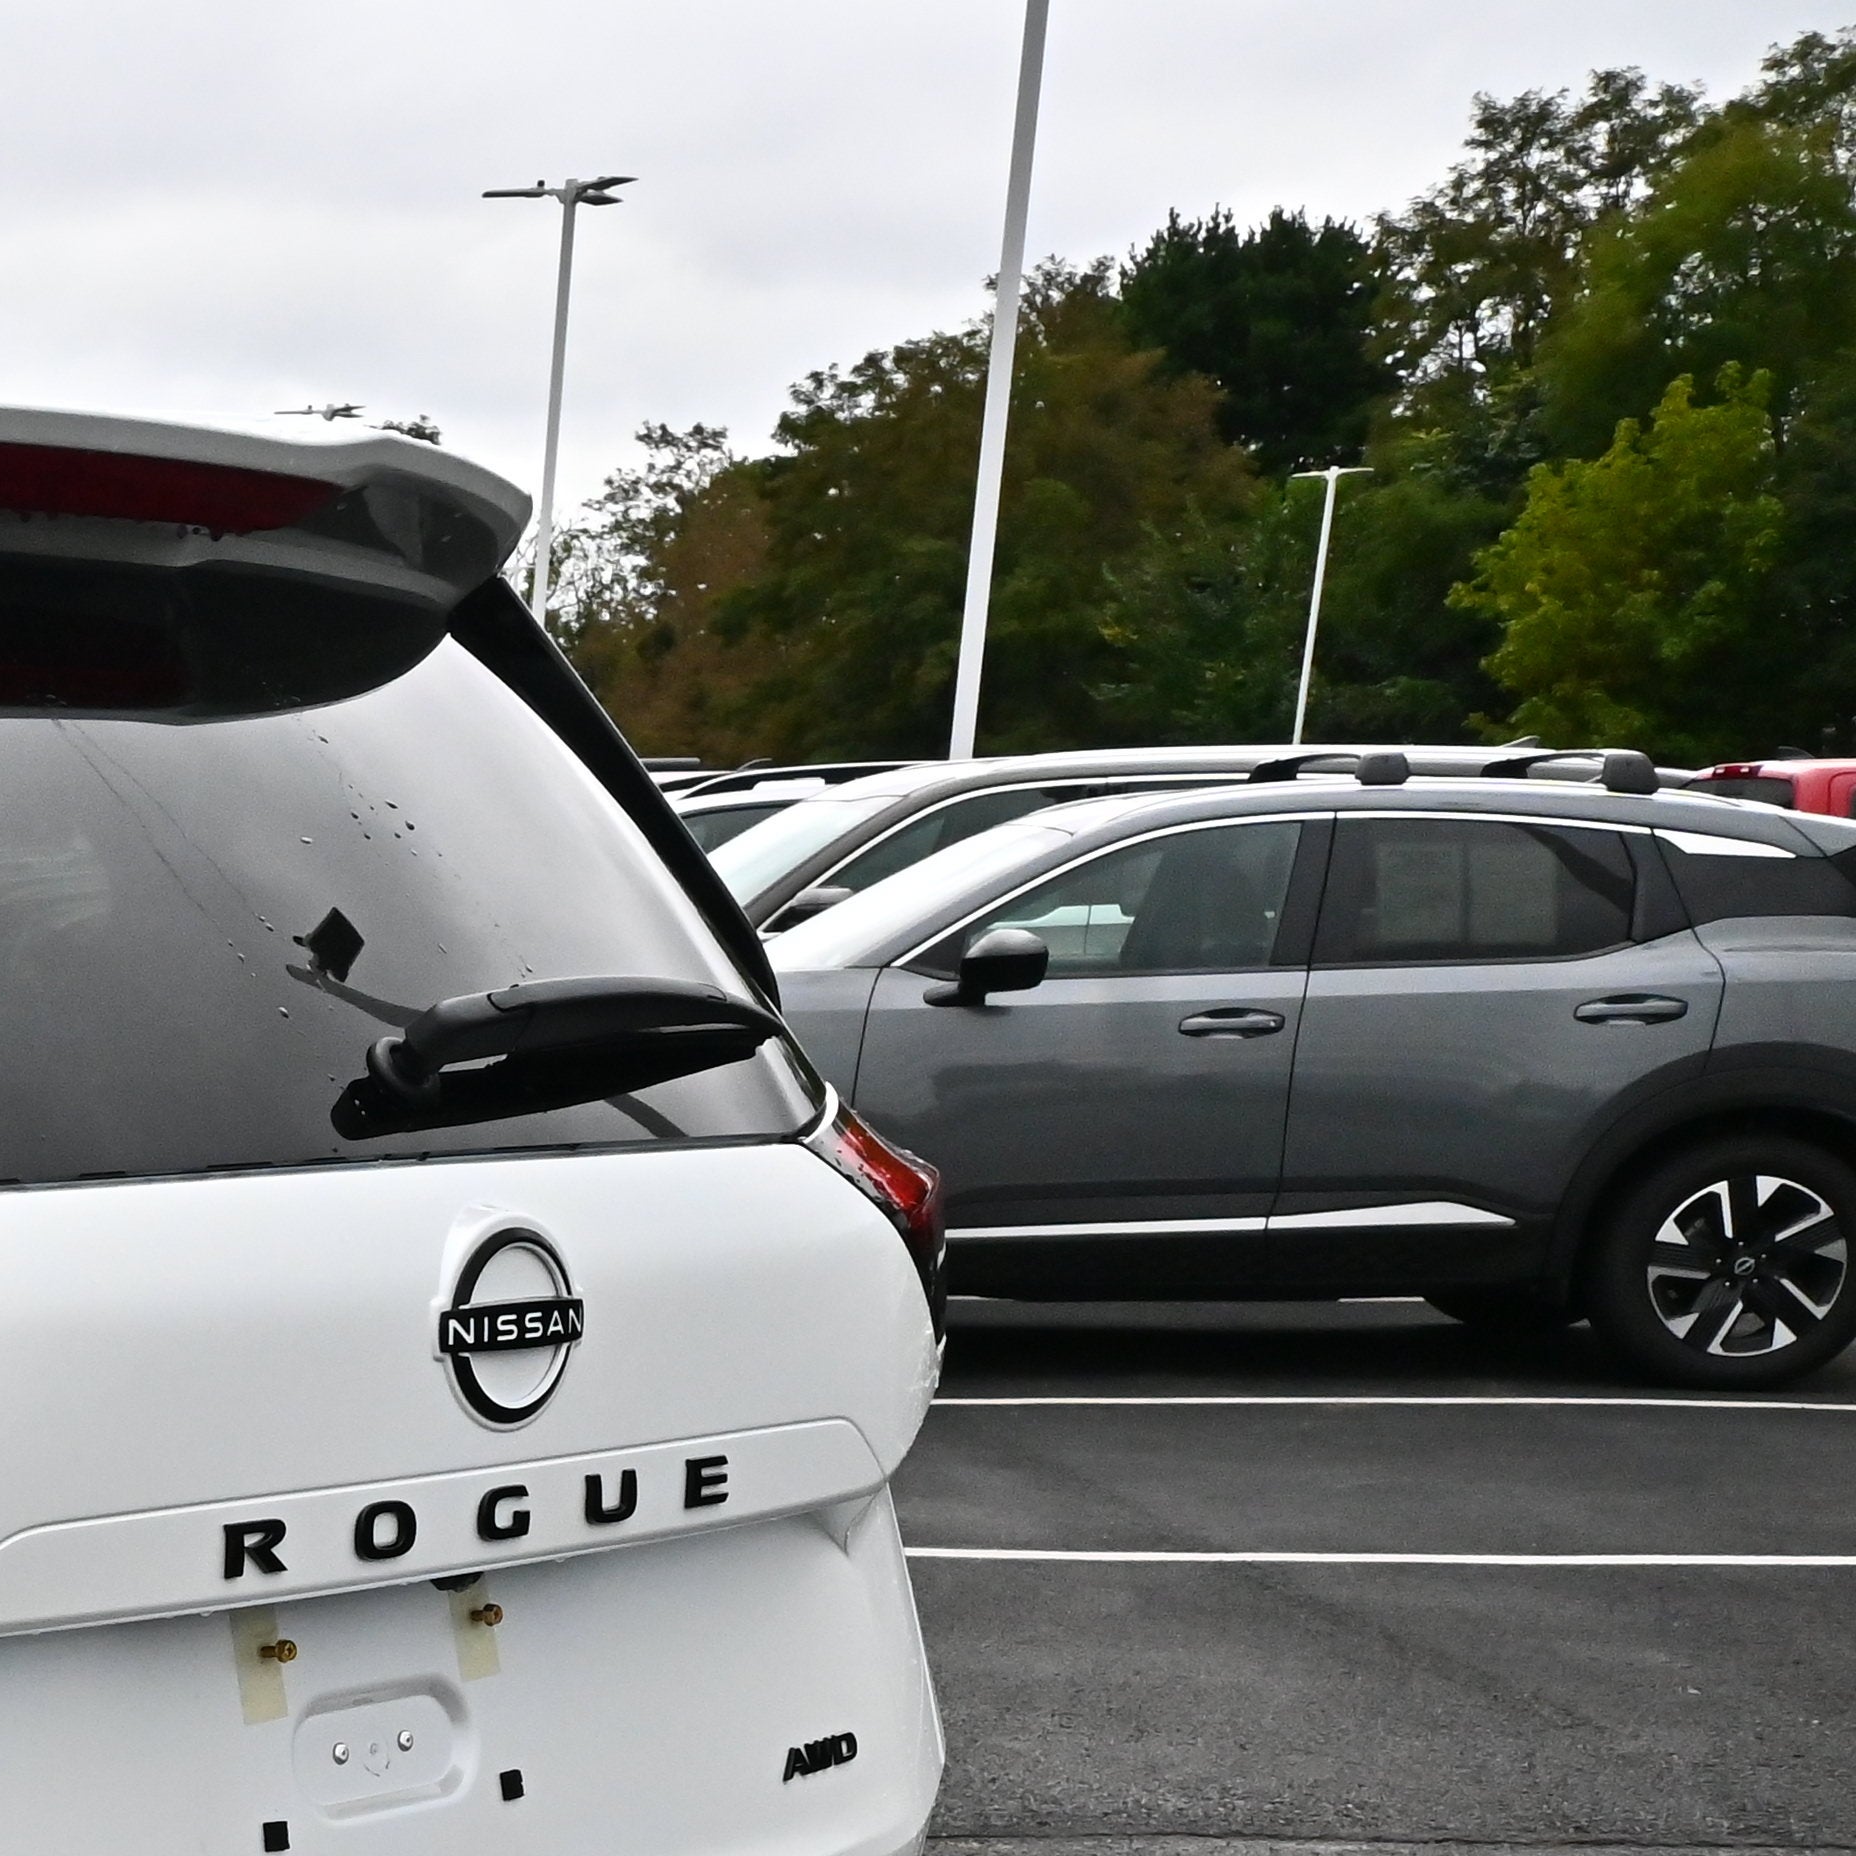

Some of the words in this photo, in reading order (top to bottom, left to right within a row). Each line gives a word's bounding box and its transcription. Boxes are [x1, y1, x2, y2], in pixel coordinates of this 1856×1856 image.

[448, 1305, 583, 1346] NISSAN
[222, 1455, 731, 1580] ROGUE
[782, 1731, 858, 1783] AWD
